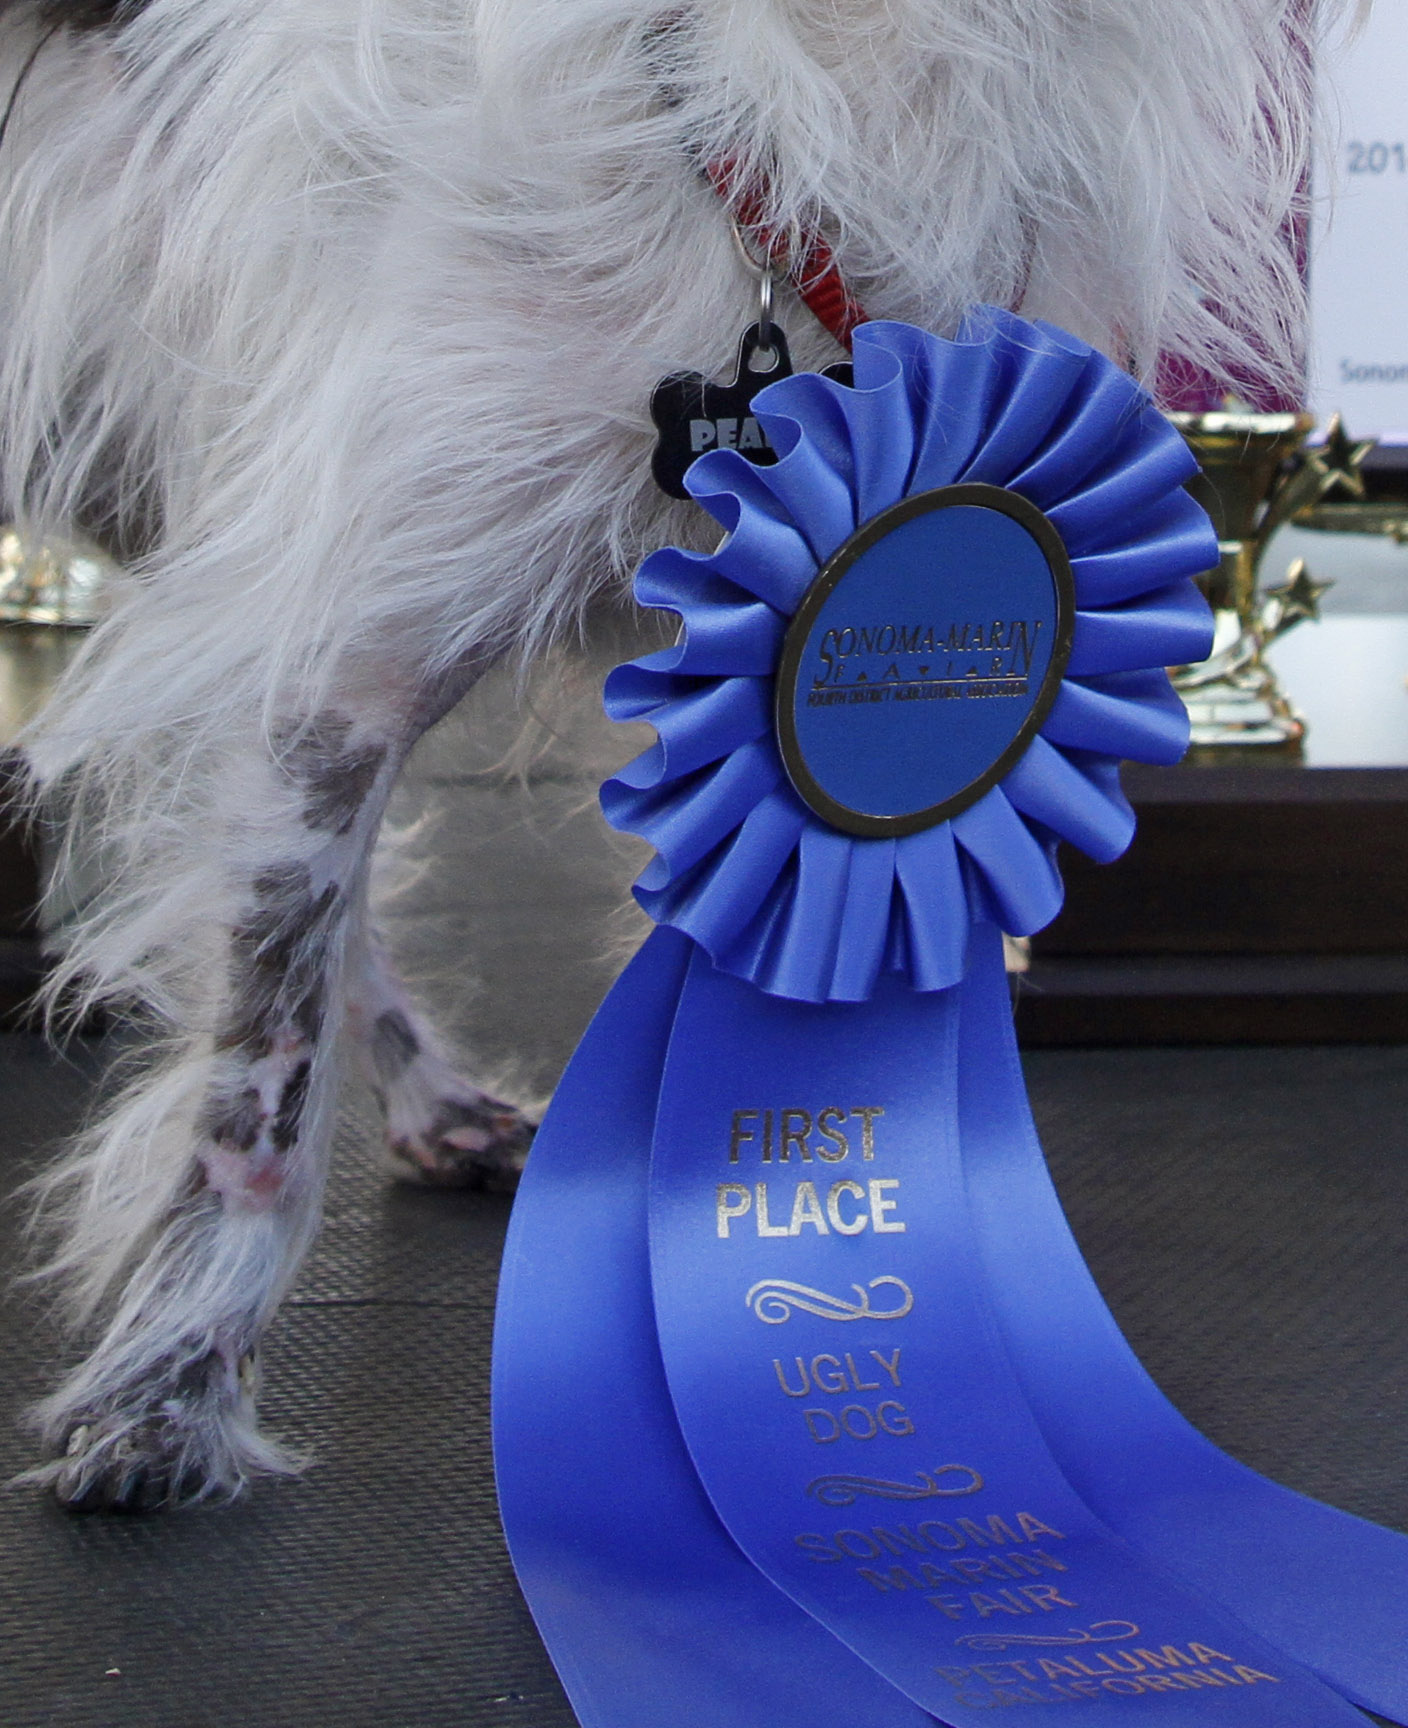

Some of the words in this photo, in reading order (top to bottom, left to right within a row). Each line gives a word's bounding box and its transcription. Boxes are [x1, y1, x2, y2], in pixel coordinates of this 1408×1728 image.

[690, 417, 773, 452] PEA
[812, 621, 1042, 690] SONOMA-MARIN
[728, 1106, 885, 1164] FIRST
[716, 1178, 907, 1239] PLACE
[772, 1348, 902, 1398] UGLY
[802, 1400, 916, 1445] DOG
[794, 1511, 1067, 1563] SONOMA
[856, 1548, 1070, 1592] MARIN
[926, 1584, 1079, 1620] FAIR
[933, 1641, 1236, 1688] PETALUMA
[953, 1664, 1282, 1710] CALIFORNIA
